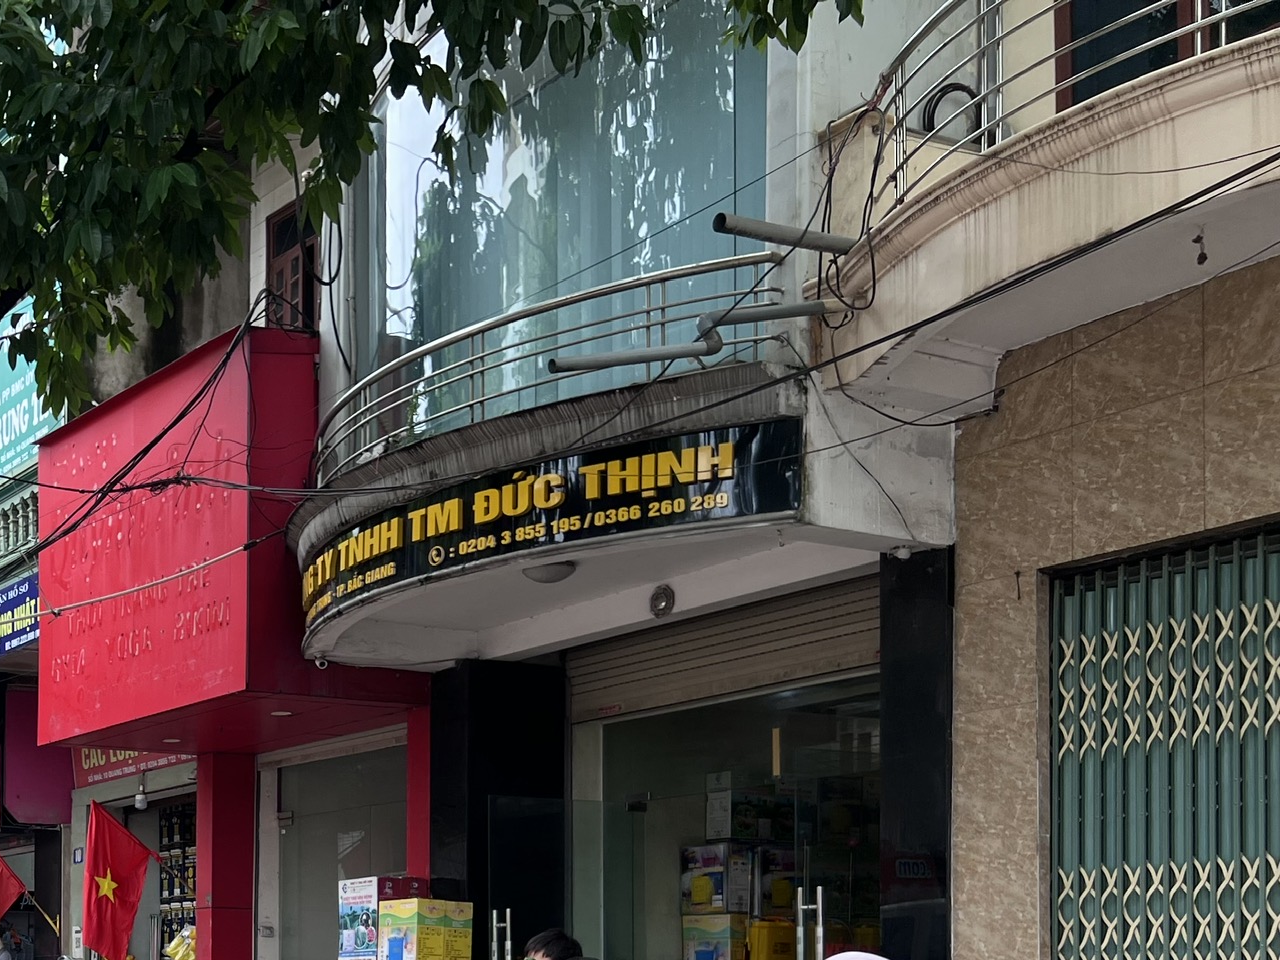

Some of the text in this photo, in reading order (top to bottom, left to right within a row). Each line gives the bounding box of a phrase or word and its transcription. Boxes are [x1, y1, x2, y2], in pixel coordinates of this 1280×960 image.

[316, 548, 337, 586] TY
[338, 517, 402, 572] TNHH
[408, 498, 462, 542] TM
[473, 471, 566, 525] ĐỨC
[579, 442, 735, 499] THỊNH
[458, 535, 496, 556] 0204
[500, 530, 512, 545] 3
[515, 523, 546, 542] 855
[648, 498, 685, 518] 260
[690, 492, 728, 511] 289
[365, 561, 397, 585] GIANG
[13, 597, 36, 632] NHẬT
